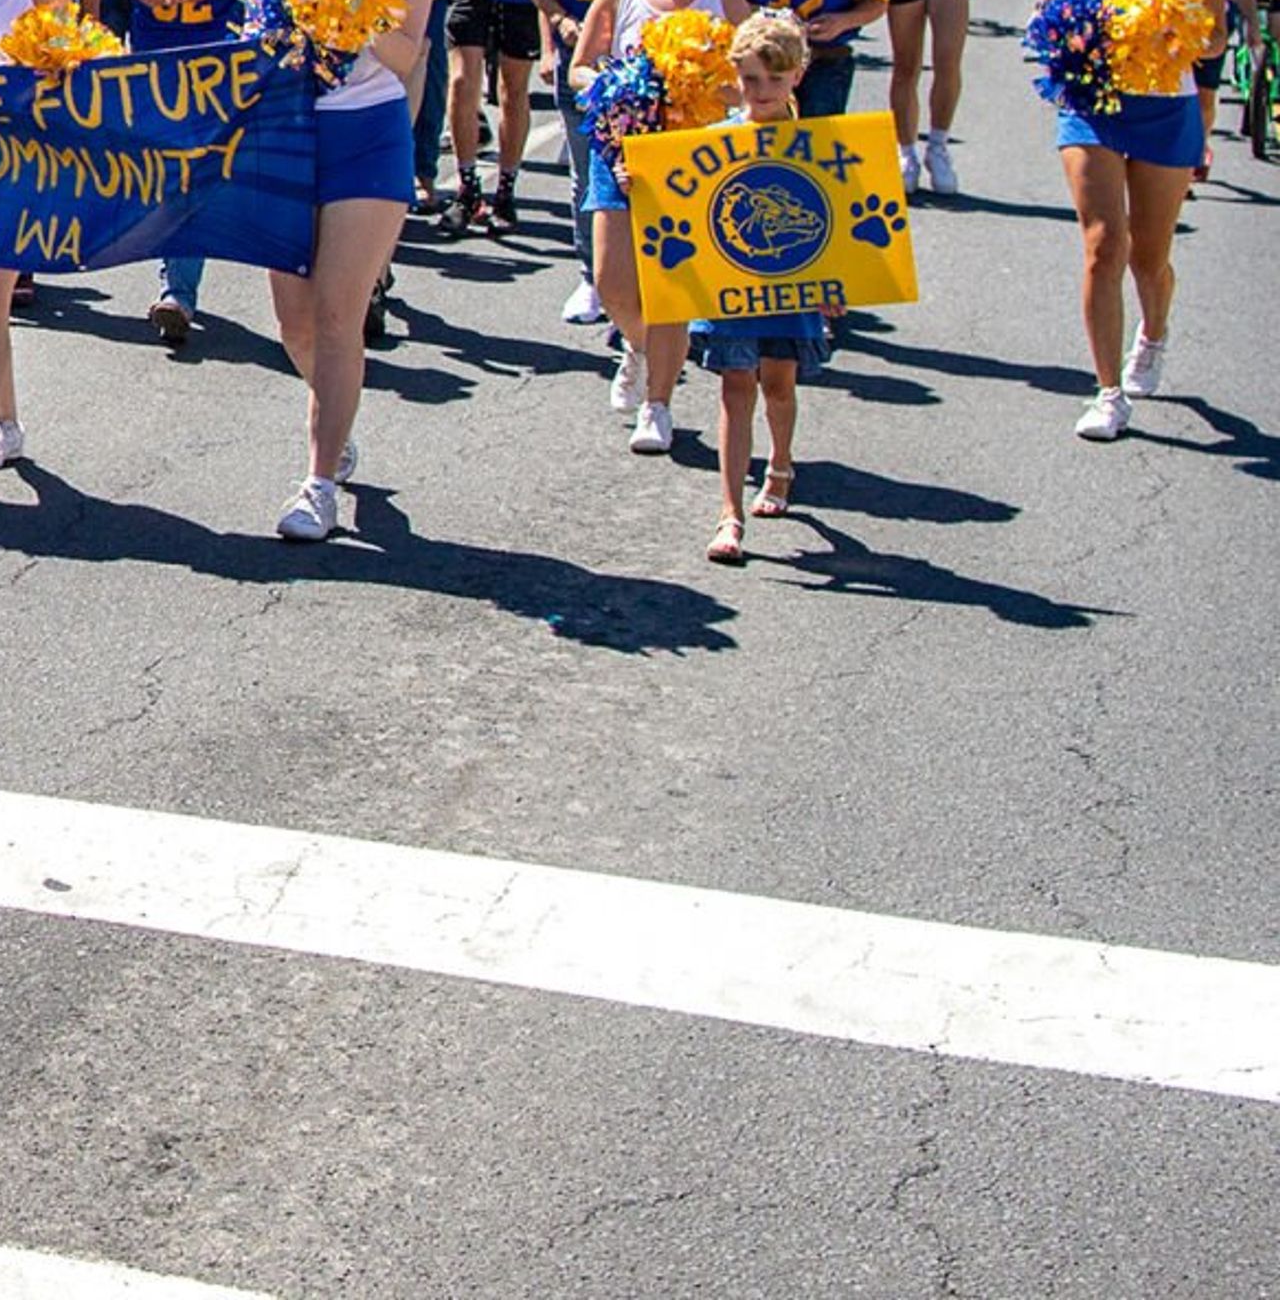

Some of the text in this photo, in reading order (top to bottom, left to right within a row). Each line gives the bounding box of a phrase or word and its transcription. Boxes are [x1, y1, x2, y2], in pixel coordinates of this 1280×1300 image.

[32, 49, 262, 130] FUTURE
[666, 125, 863, 198] COLFAX
[14, 208, 82, 265] WA
[719, 280, 847, 315] CHEER
